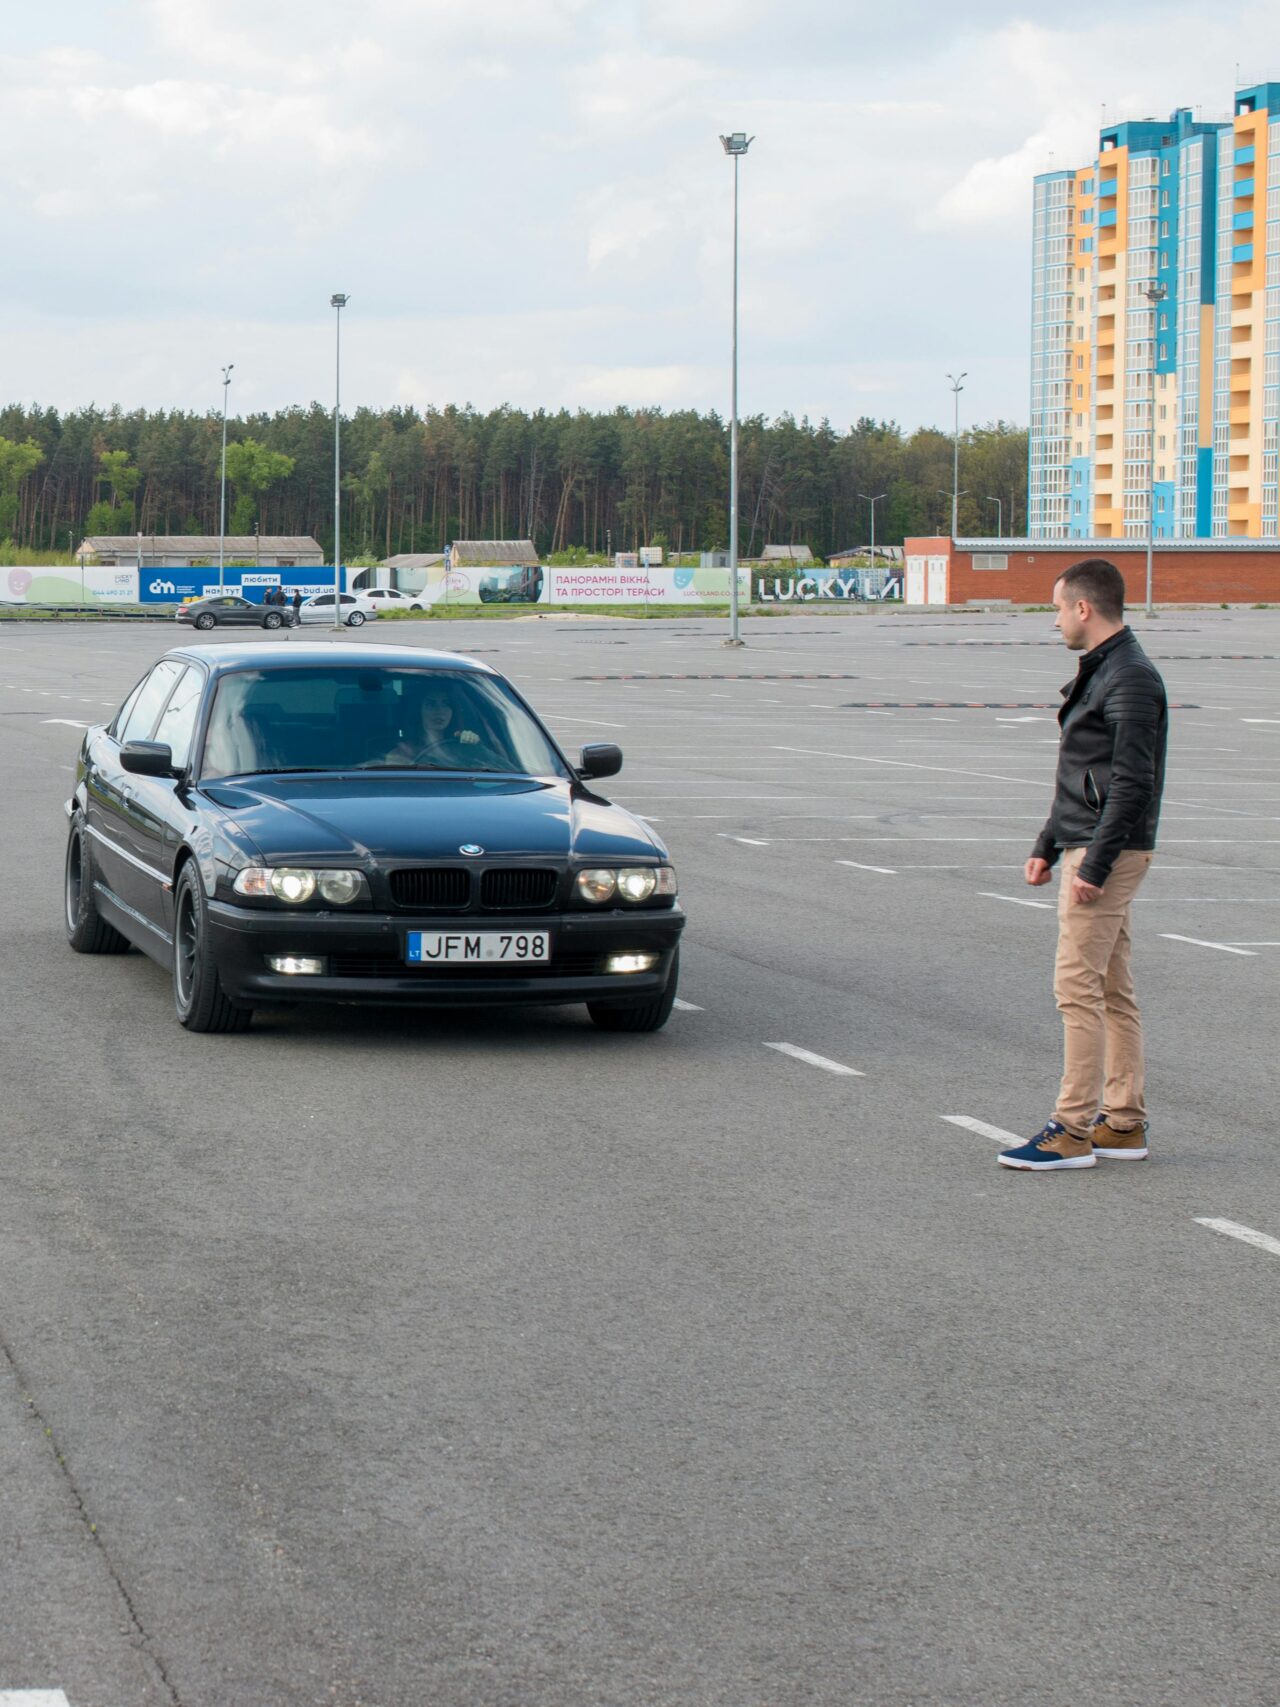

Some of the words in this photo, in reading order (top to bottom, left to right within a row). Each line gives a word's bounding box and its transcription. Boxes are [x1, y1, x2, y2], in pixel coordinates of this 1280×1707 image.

[556, 576, 617, 584] ПАНОРАМНІ
[620, 576, 650, 584] ВІКНА
[555, 588, 568, 596] ТА
[571, 588, 624, 596] ПРОСТОРІ
[626, 588, 665, 596] ТЕРАСИ
[425, 936, 481, 959] JFM
[500, 935, 545, 958] 798
[409, 950, 421, 958] LT
